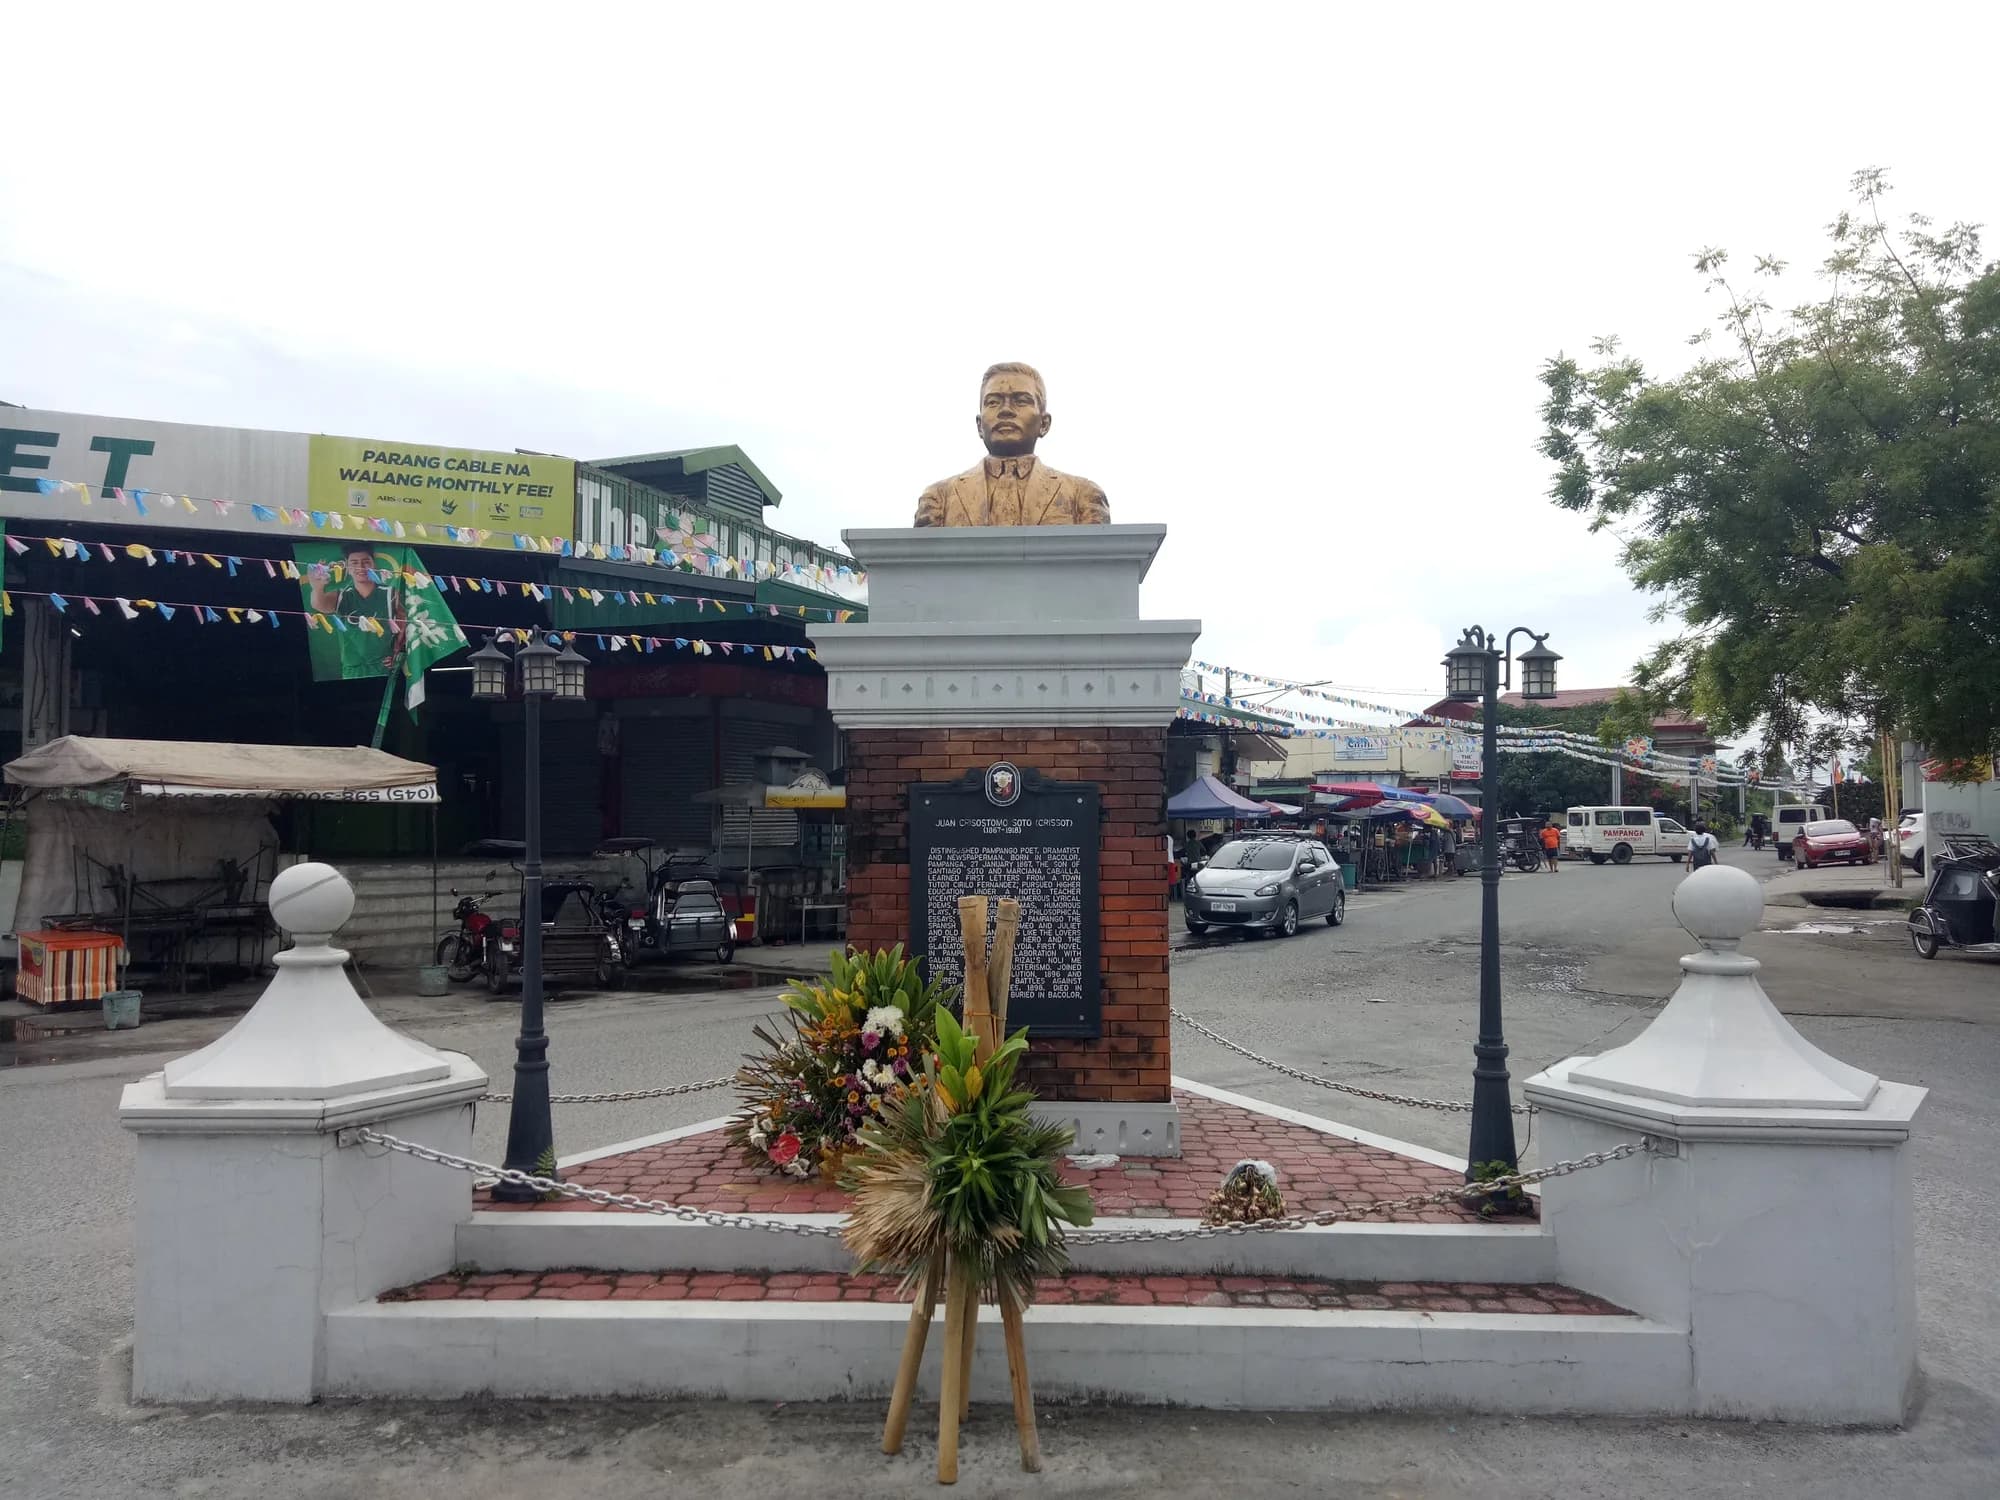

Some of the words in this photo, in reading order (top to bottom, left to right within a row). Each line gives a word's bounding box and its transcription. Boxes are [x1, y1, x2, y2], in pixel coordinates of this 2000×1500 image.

[363, 450, 440, 469] PARANG
[444, 458, 502, 476] CABLE
[505, 463, 530, 477] NA
[340, 468, 423, 487] WALANG
[426, 476, 513, 495] MONTHLY
[516, 483, 554, 498] FEE!
[387, 786, 435, 800] (045)
